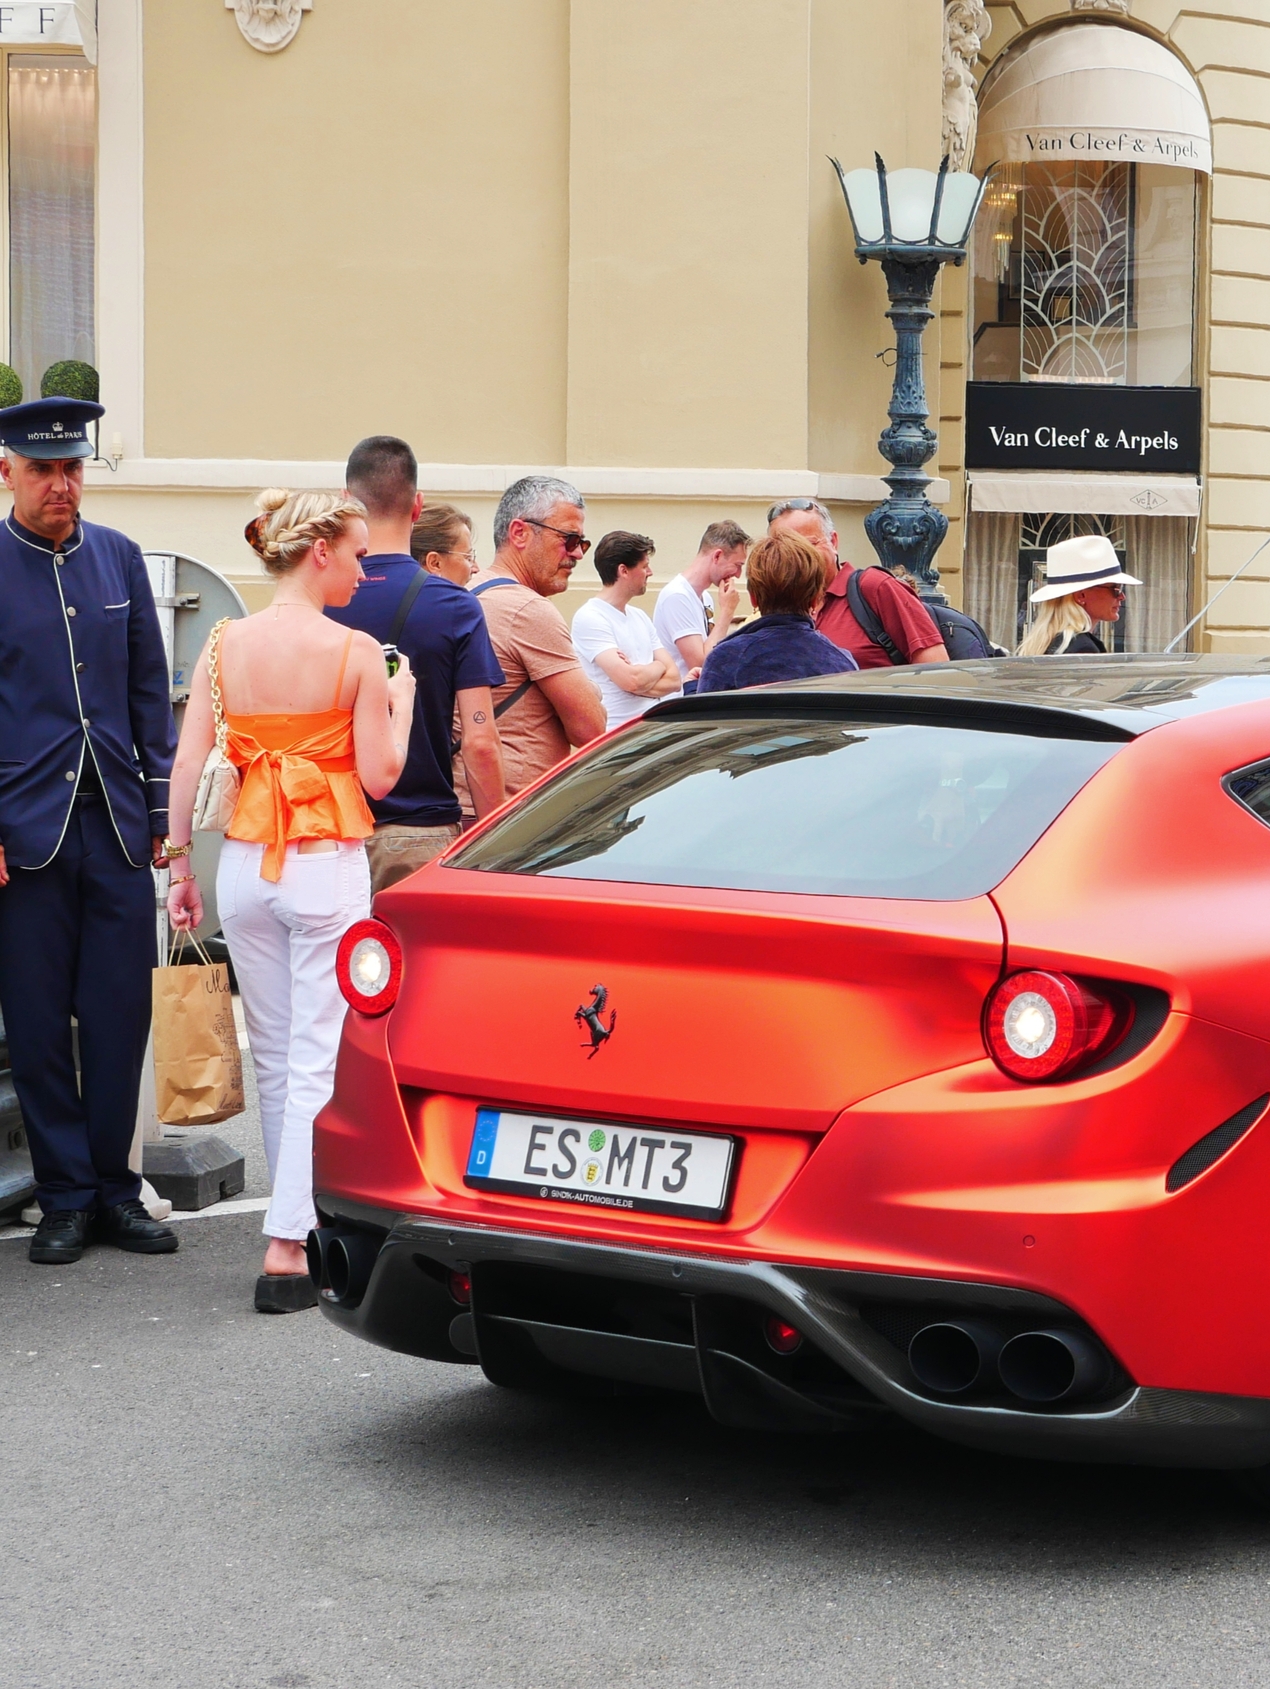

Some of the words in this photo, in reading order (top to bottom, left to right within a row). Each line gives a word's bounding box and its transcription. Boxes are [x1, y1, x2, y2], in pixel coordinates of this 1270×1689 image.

[1026, 133, 1062, 151] Van
[1070, 132, 1127, 151] Cleef
[1133, 138, 1146, 153] &
[1152, 137, 1199, 162] Arpels
[988, 426, 1029, 447] Van
[1034, 426, 1090, 448] Cleef
[1094, 432, 1110, 448] &
[1115, 429, 1179, 456] Arpels
[476, 1150, 486, 1165] D
[524, 1124, 581, 1179] ES
[605, 1134, 693, 1193] MT3
